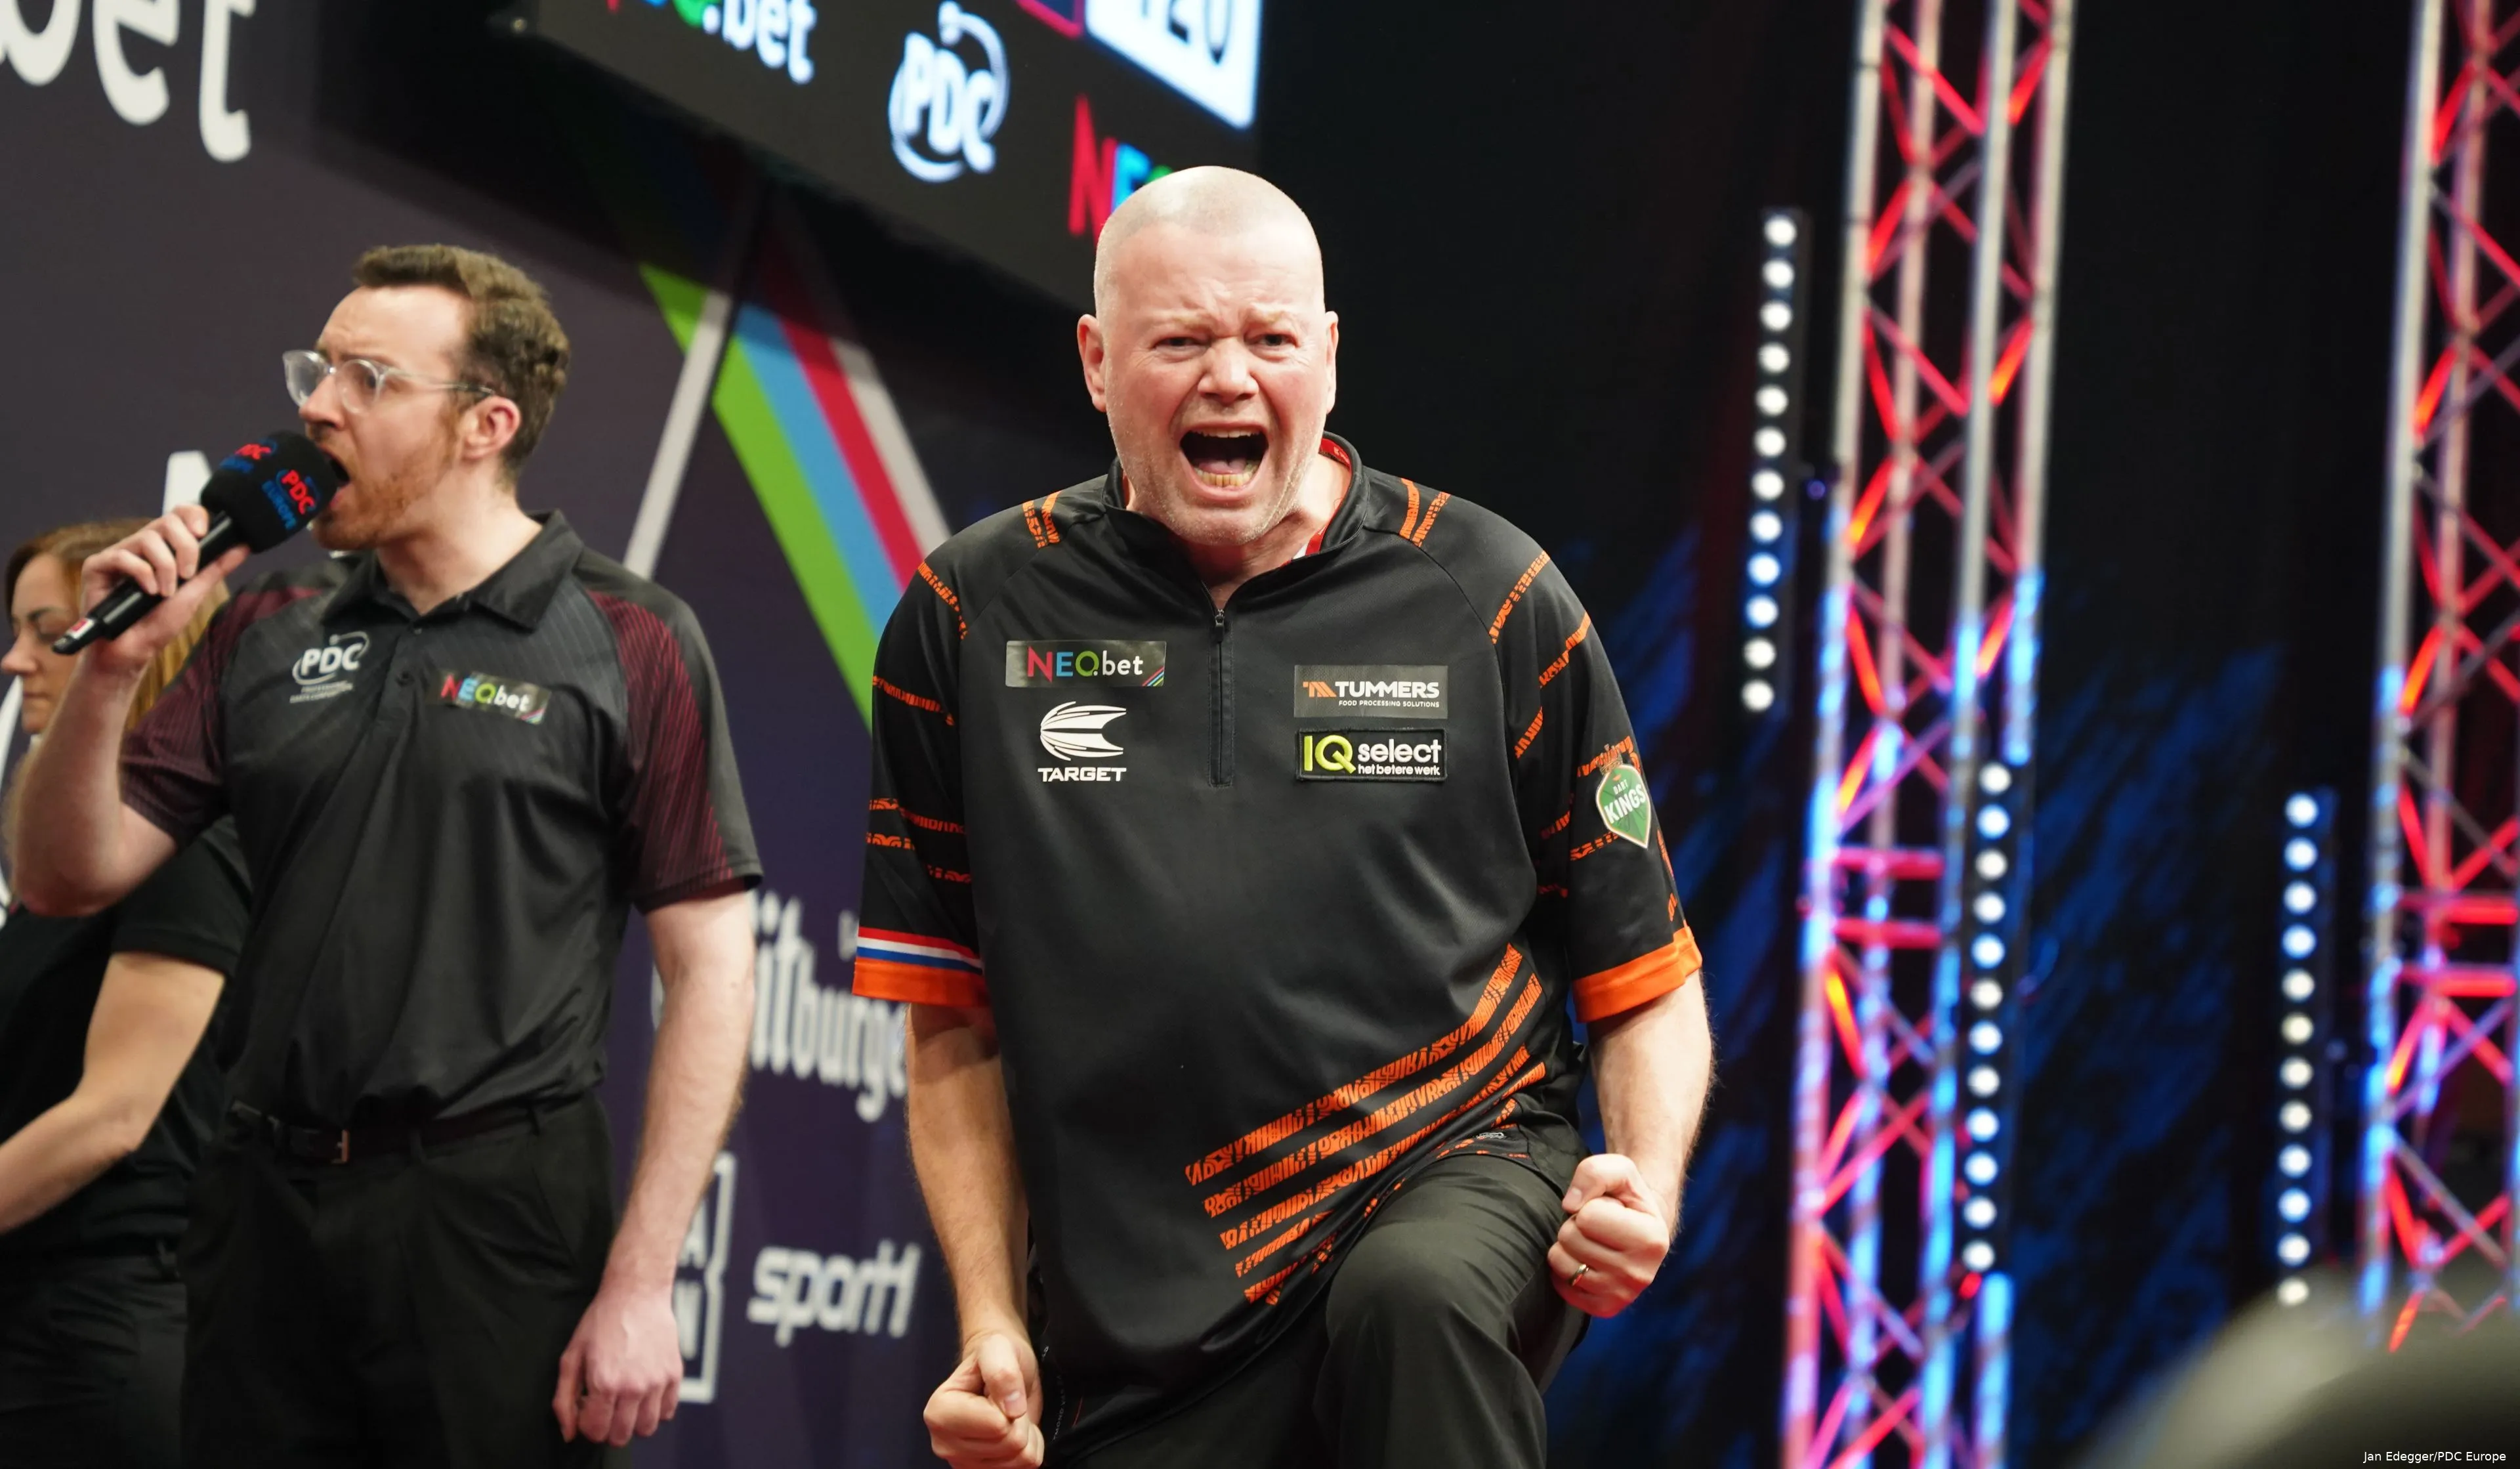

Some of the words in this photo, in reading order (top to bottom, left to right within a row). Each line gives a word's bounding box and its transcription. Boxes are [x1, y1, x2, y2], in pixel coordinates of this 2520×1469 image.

[903, 32, 997, 175] PDC
[261, 480, 297, 530] EUROPE
[281, 469, 316, 515] PDC
[301, 643, 364, 676] PDC
[1335, 681, 1440, 698] TUMMERS
[1303, 734, 1356, 774] IQ
[1357, 738, 1442, 763] select
[1414, 765, 1441, 776] werk
[1038, 767, 1127, 782] TARGET
[1613, 779, 1628, 795] DART
[1604, 784, 1647, 824] KINGS
